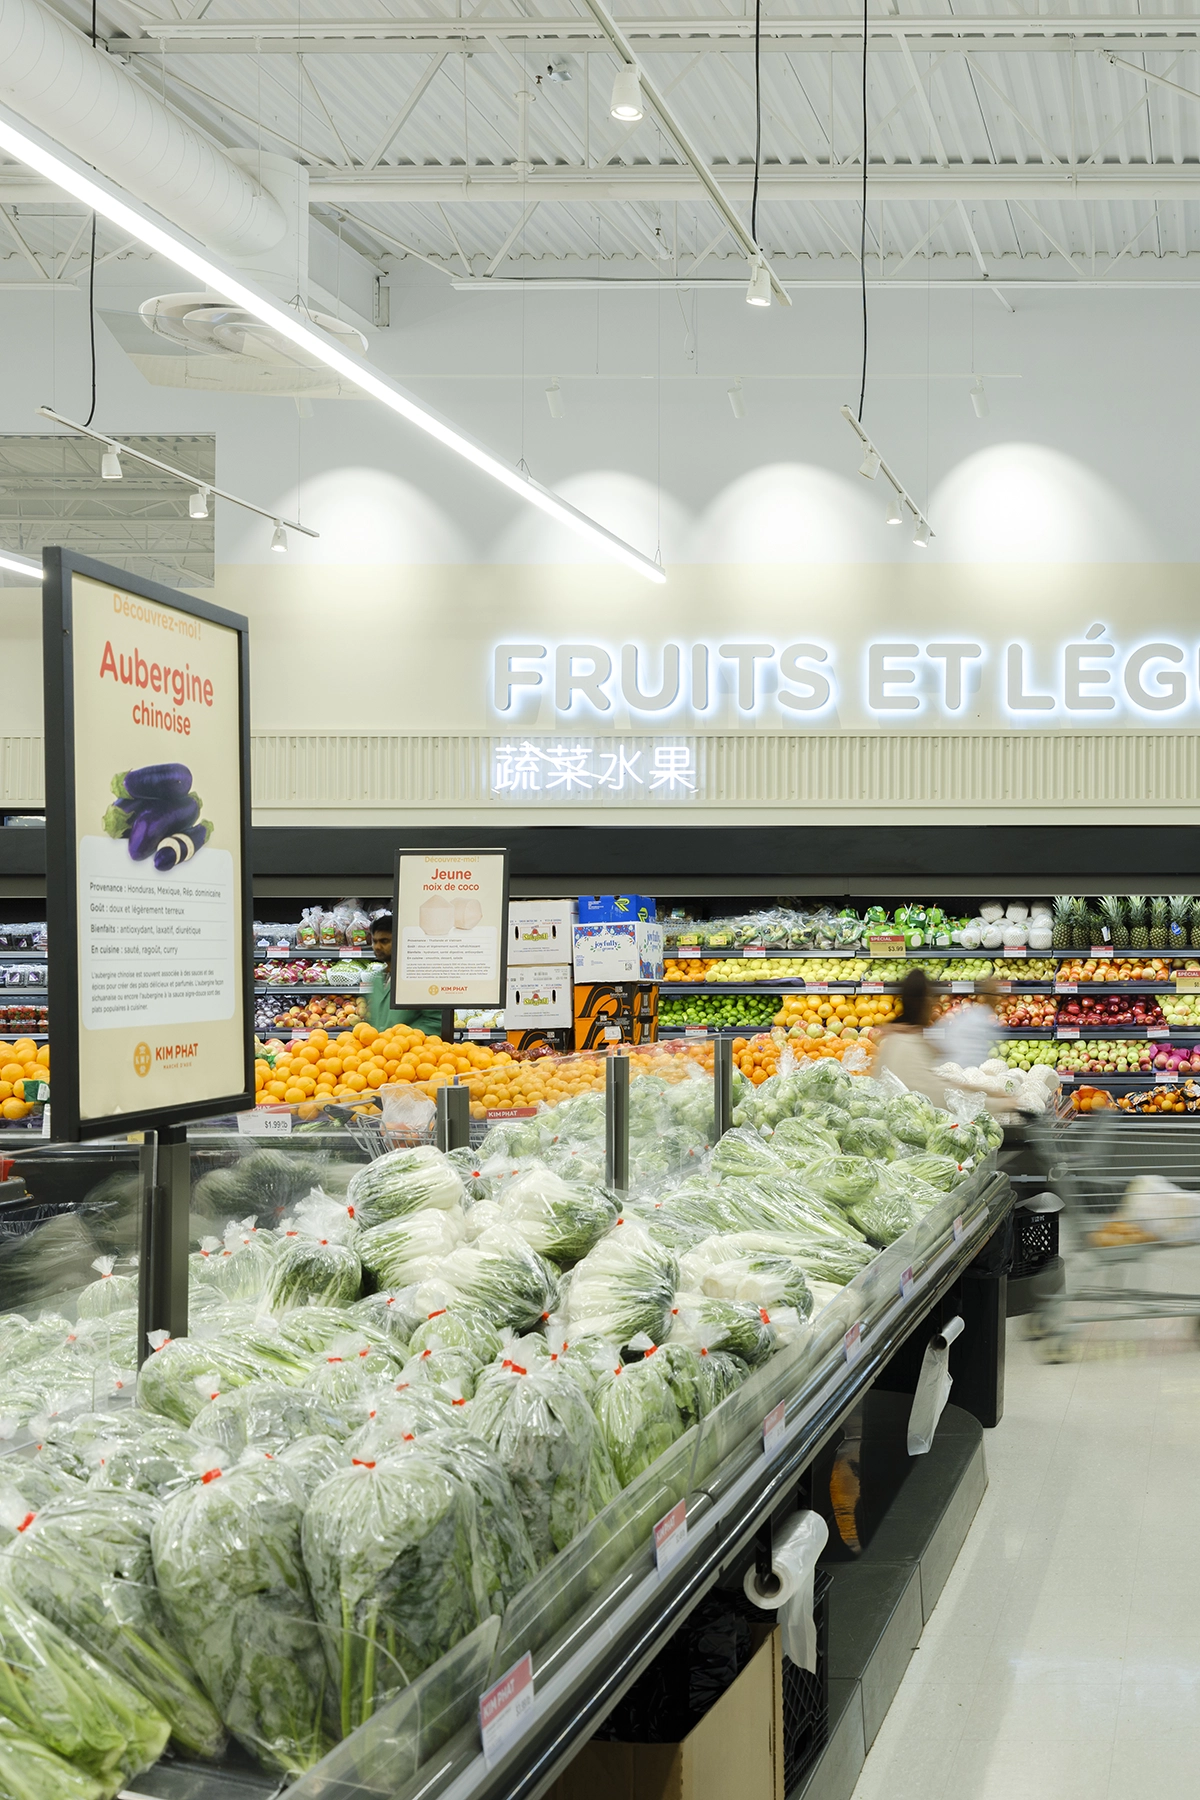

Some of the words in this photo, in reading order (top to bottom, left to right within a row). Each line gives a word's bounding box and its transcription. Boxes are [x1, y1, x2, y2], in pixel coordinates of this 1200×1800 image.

[99, 640, 214, 707] Aubergine
[494, 643, 831, 711] FRUITS
[868, 643, 982, 711] ET
[132, 700, 191, 735] chinoise
[493, 741, 698, 793] 蔬菜水果
[431, 868, 472, 880] Jeune
[89, 882, 123, 893] Provenance
[127, 885, 156, 896] Honduras,
[157, 886, 181, 897] Mexique,
[423, 882, 442, 891] noix
[444, 882, 455, 891] de
[90, 903, 105, 912] Goût
[109, 904, 123, 913] doux
[125, 905, 131, 913] et
[132, 905, 164, 915] légèrement
[165, 906, 184, 915] terreux
[90, 924, 116, 933] Bienfaits
[175, 925, 201, 936] diurétique
[91, 945, 99, 954] En
[99, 945, 120, 954] cuisine
[124, 945, 141, 955] sauté,
[163, 946, 178, 955] curry
[155, 1045, 174, 1061] KIM
[175, 1043, 199, 1059] PHAT
[483, 1702, 498, 1720] KIM
[496, 1678, 515, 1706] PHAT
